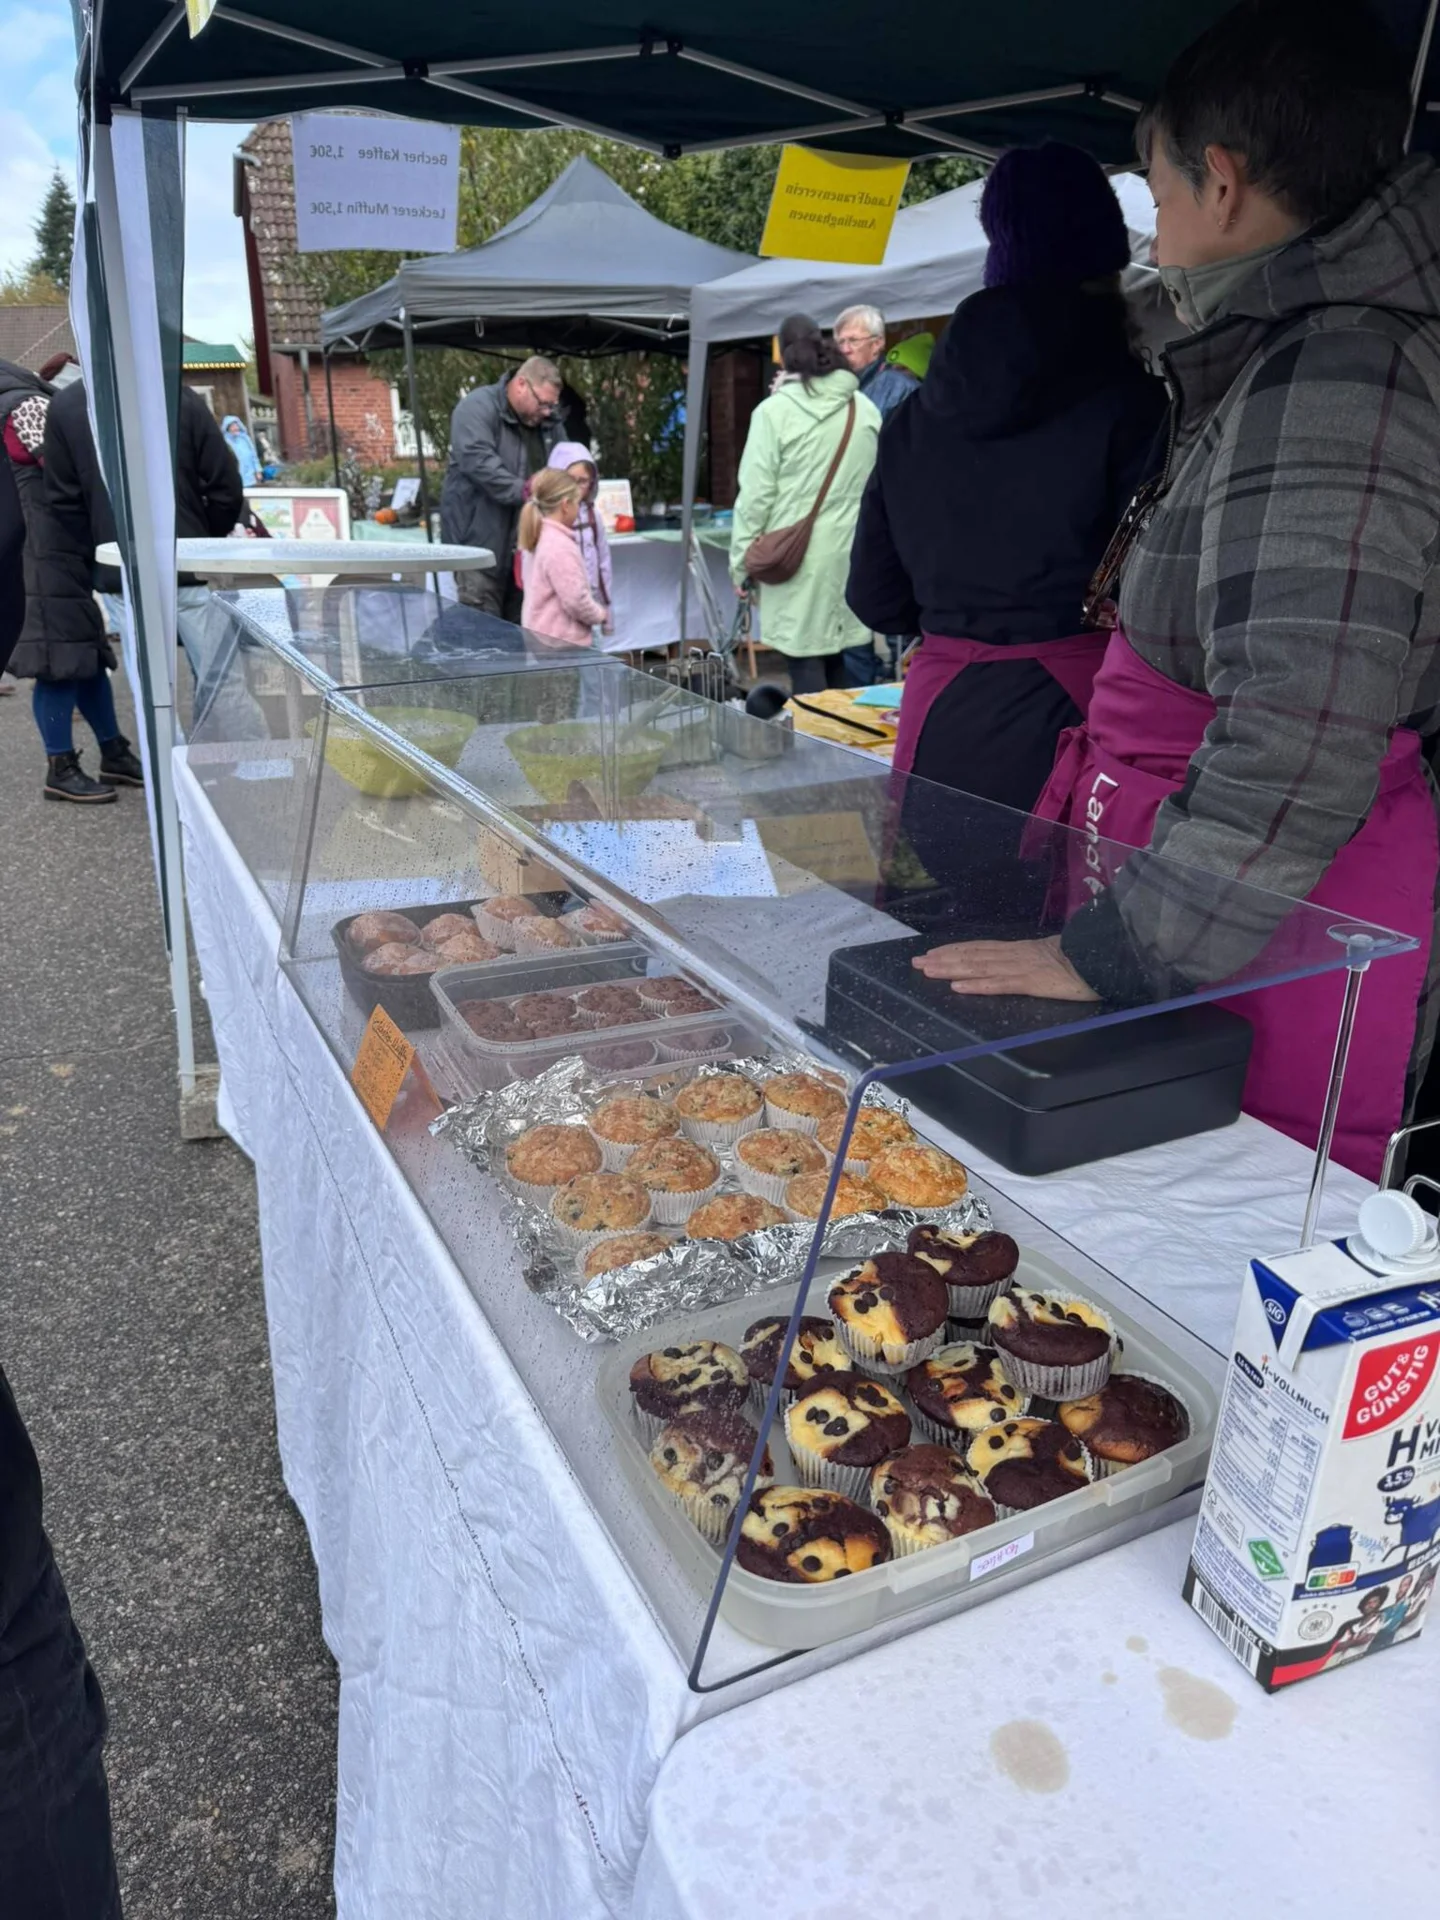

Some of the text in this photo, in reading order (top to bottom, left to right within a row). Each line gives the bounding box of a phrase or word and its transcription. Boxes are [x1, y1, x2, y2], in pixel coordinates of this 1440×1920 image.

[1266, 1302, 1283, 1321] SIG
[1261, 1363, 1330, 1424] H-VOLLMILCH
[1356, 1345, 1429, 1424] GÜNSTIG
